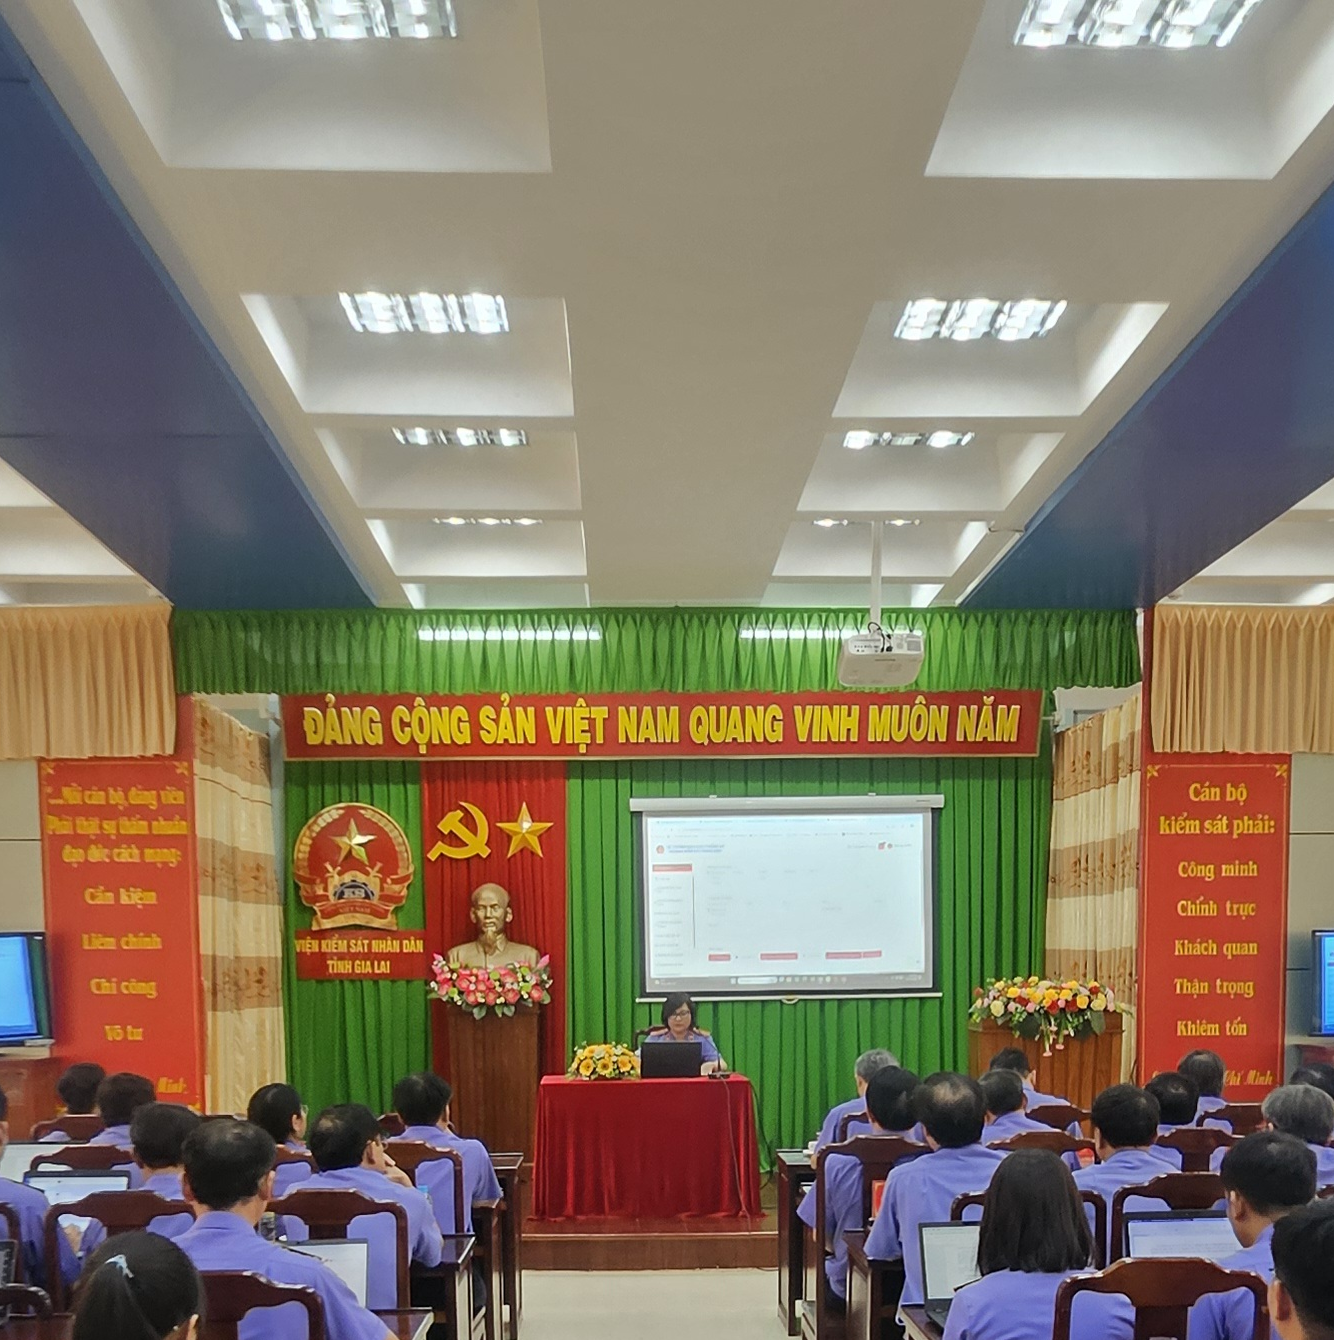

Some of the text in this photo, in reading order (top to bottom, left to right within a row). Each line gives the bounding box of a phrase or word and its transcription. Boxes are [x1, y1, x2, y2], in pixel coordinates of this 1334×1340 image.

[303, 692, 1021, 754] ĐẢNG CỘNG SẢN VIỆT NAM QUANG VINH MUÔN NĂM
[1189, 781, 1248, 806] Cán bộ
[1159, 811, 1276, 839] kiểm sát phải:
[1178, 860, 1258, 881] Công minh
[1177, 895, 1257, 920] Chính trực
[294, 933, 424, 956] VIỆN KIỂM SÁT NHÂN DÂN
[1174, 938, 1259, 959] Khách quan
[327, 956, 391, 974] TỈNH GIA LAI
[120, 978, 158, 999] công
[1173, 978, 1255, 999] Thận trọng
[1176, 1016, 1248, 1037] Khiêm tốn
[1244, 1069, 1273, 1086] Minh
